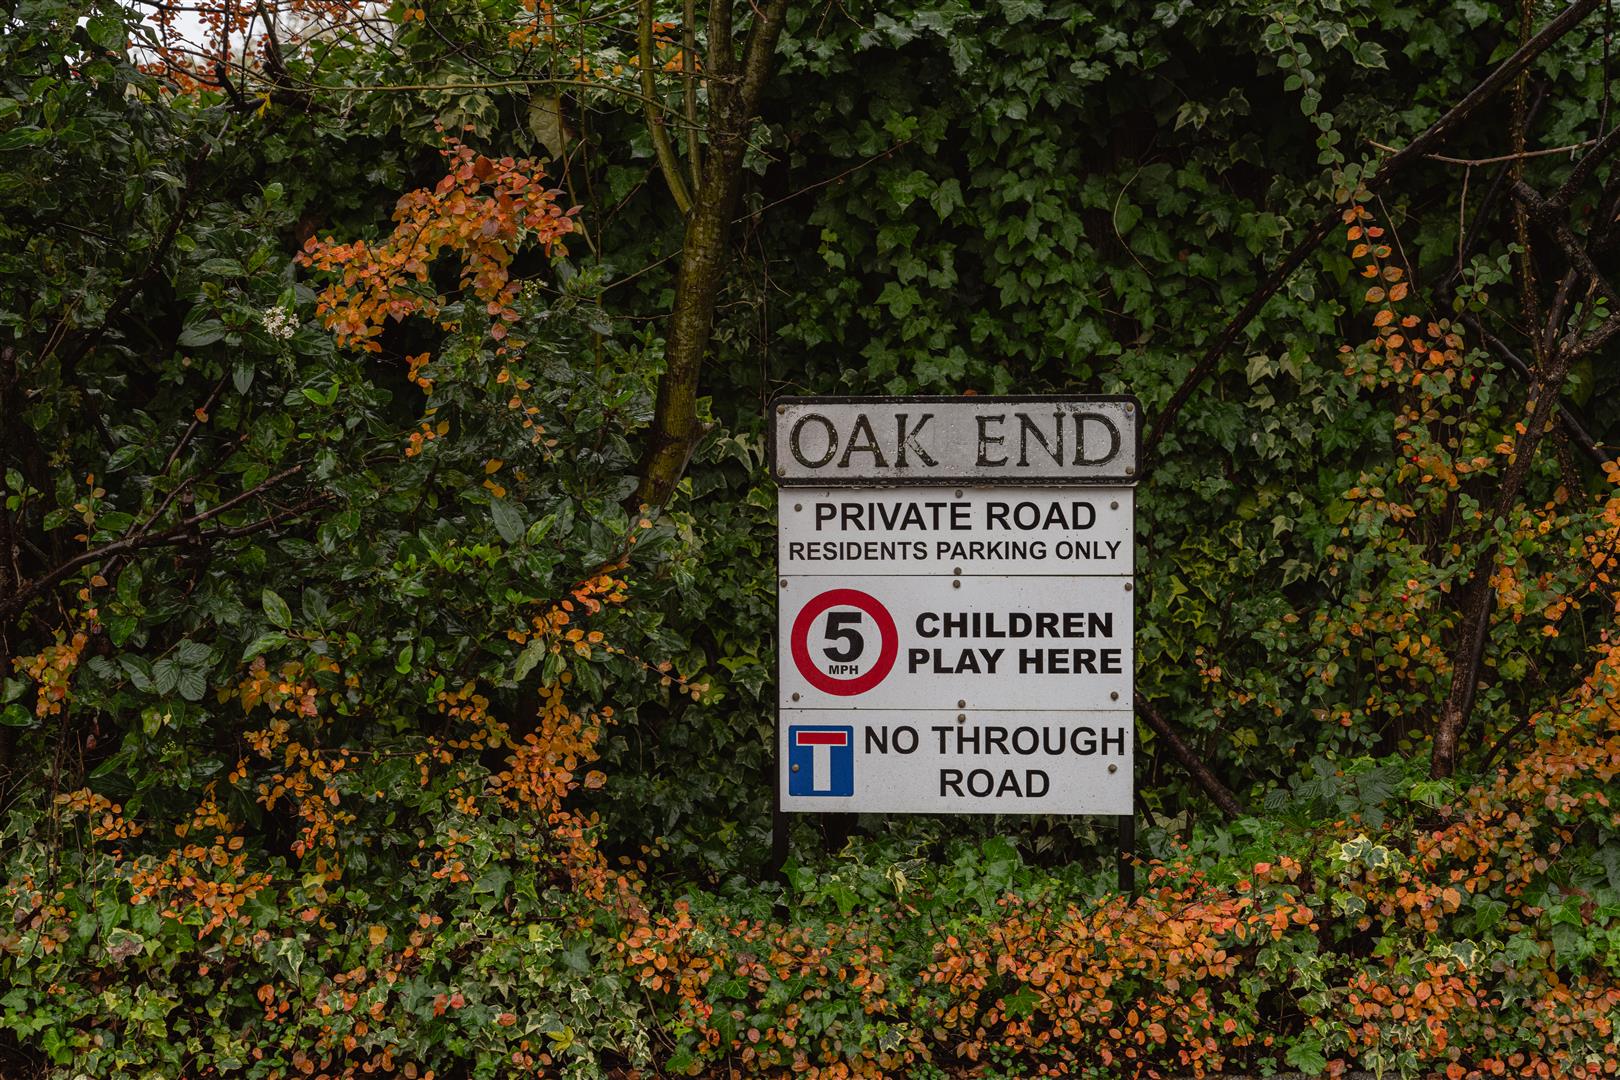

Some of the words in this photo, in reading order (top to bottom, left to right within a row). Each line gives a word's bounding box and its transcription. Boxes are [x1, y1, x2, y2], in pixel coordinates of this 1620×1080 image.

[789, 412, 939, 469] OAK
[975, 411, 1121, 467] END
[814, 501, 972, 531] PRIVATE
[986, 501, 1097, 530] ROAD
[788, 541, 928, 561] RESIDENTS
[936, 540, 1047, 560] PARKING
[1055, 540, 1122, 560] ONLY
[822, 611, 864, 663] 5
[915, 612, 1113, 638] CHILDREN
[828, 665, 859, 675] MPH
[908, 648, 1005, 674] PLAY
[1018, 648, 1122, 674] HERE
[864, 725, 919, 755] NO
[931, 726, 1125, 756] THROUGH
[940, 768, 1050, 798] ROAD
